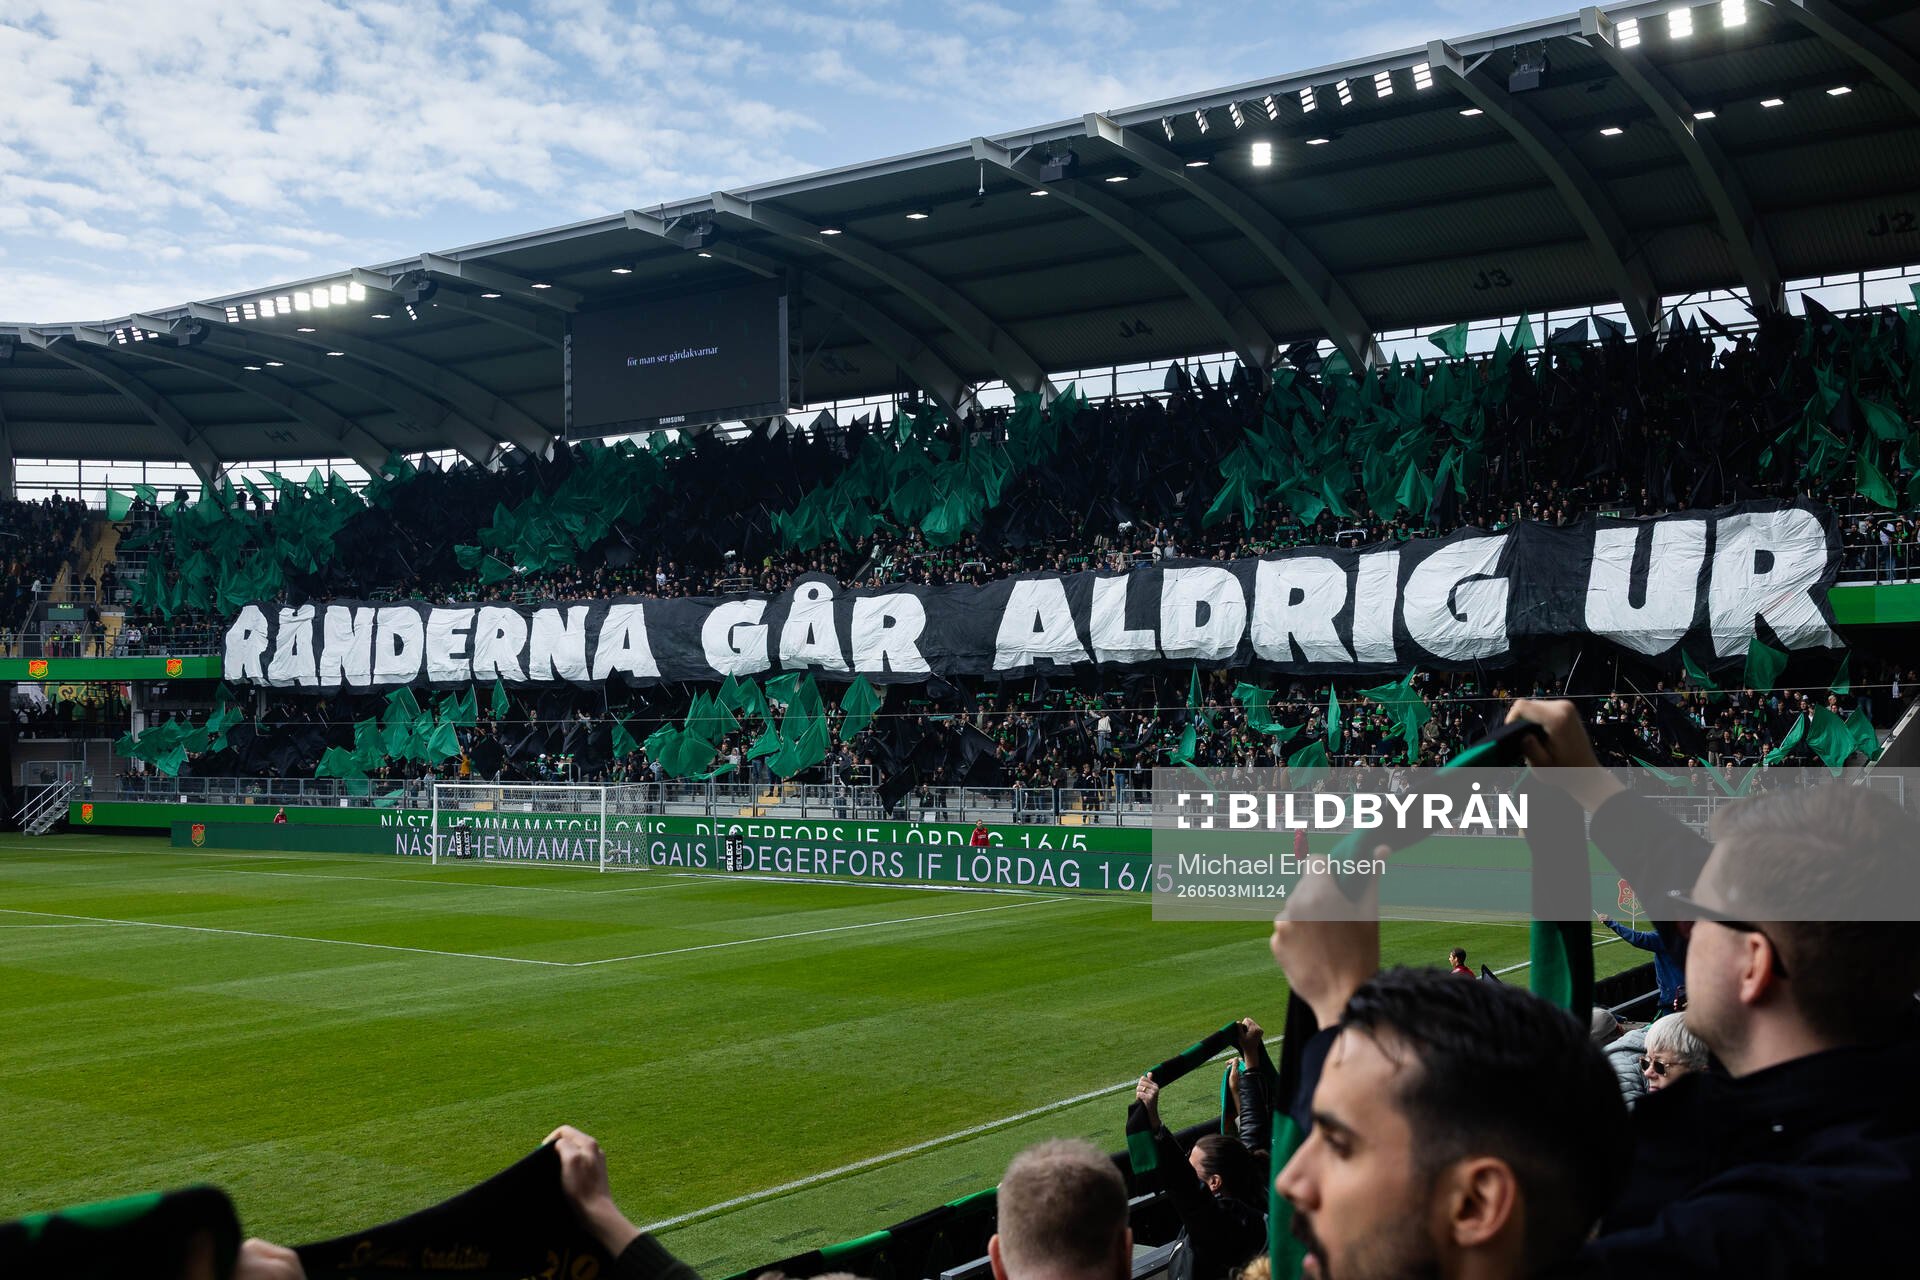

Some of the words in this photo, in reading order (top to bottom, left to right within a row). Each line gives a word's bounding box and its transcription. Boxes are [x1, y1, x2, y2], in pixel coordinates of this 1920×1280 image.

[1473, 268, 1513, 290] J3
[1119, 319, 1153, 338] J4
[627, 357, 638, 368] för
[639, 355, 656, 366] man
[656, 353, 668, 363] ser
[669, 346, 719, 363] gårdakvarnar
[659, 415, 685, 425] SAMSUNG
[224, 604, 661, 687] RÄNDERNA
[701, 581, 931, 677] GÅR
[993, 535, 1509, 670] ALDRIG
[1585, 508, 1847, 657] UR
[381, 810, 434, 827] NÄST
[892, 823, 1004, 848] ÖRDG
[396, 828, 456, 857] NÄSTA
[650, 841, 707, 867] GAIS
[743, 845, 904, 877] DEGERFORS
[918, 853, 943, 880] IF
[957, 848, 1080, 888] LÖRDAG
[1099, 862, 1174, 893] 16/5
[725, 839, 734, 873] SELECT
[735, 839, 743, 872] SELECT
